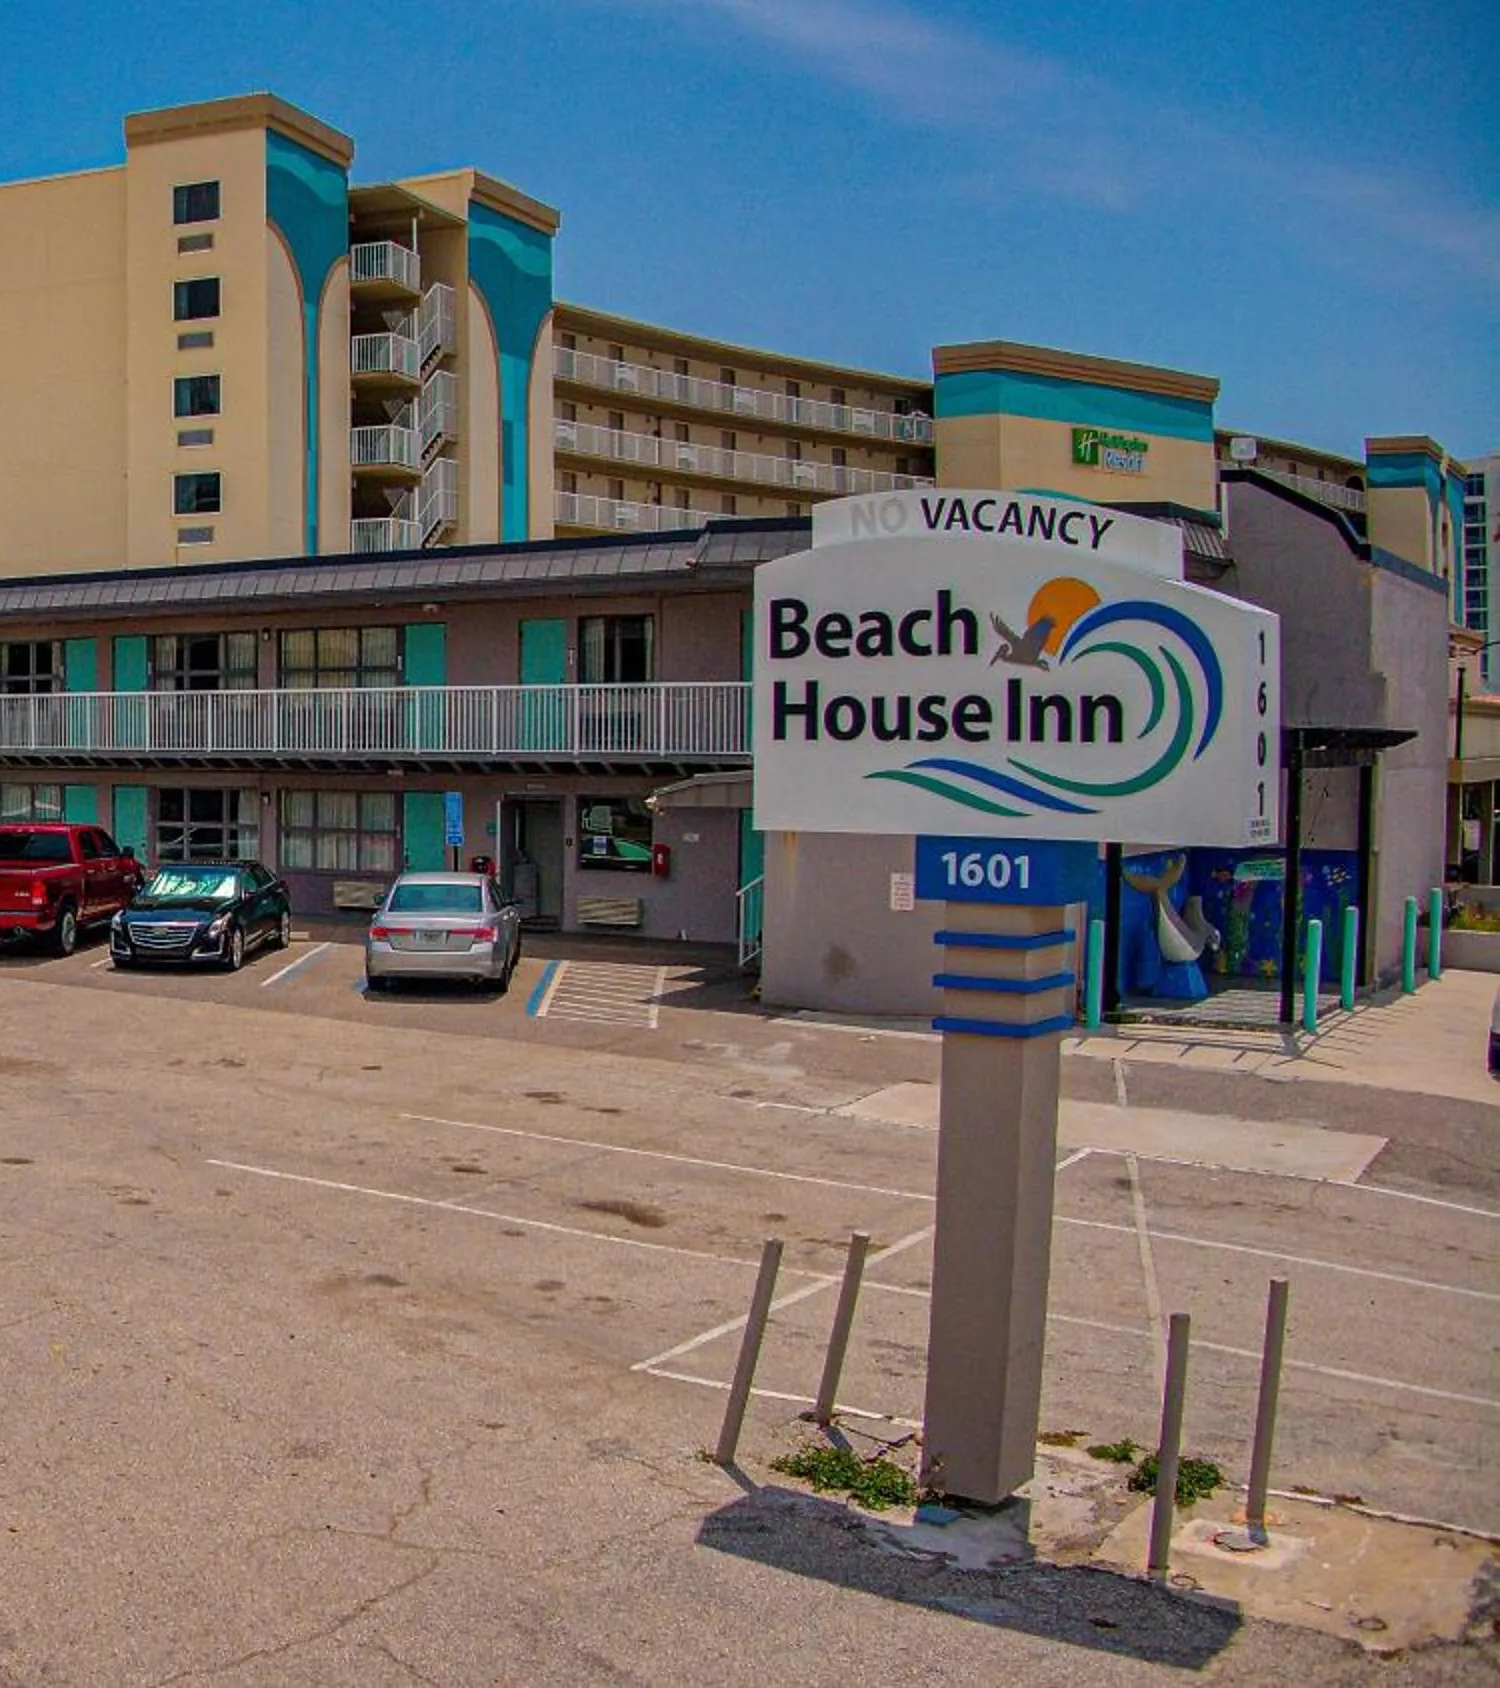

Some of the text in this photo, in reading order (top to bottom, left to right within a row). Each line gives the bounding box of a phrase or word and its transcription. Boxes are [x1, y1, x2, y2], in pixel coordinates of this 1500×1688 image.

[851, 497, 1114, 549] NO VACANCY
[769, 590, 979, 660] Beach
[772, 678, 1124, 744] House Inn
[941, 852, 1031, 888] 1601
